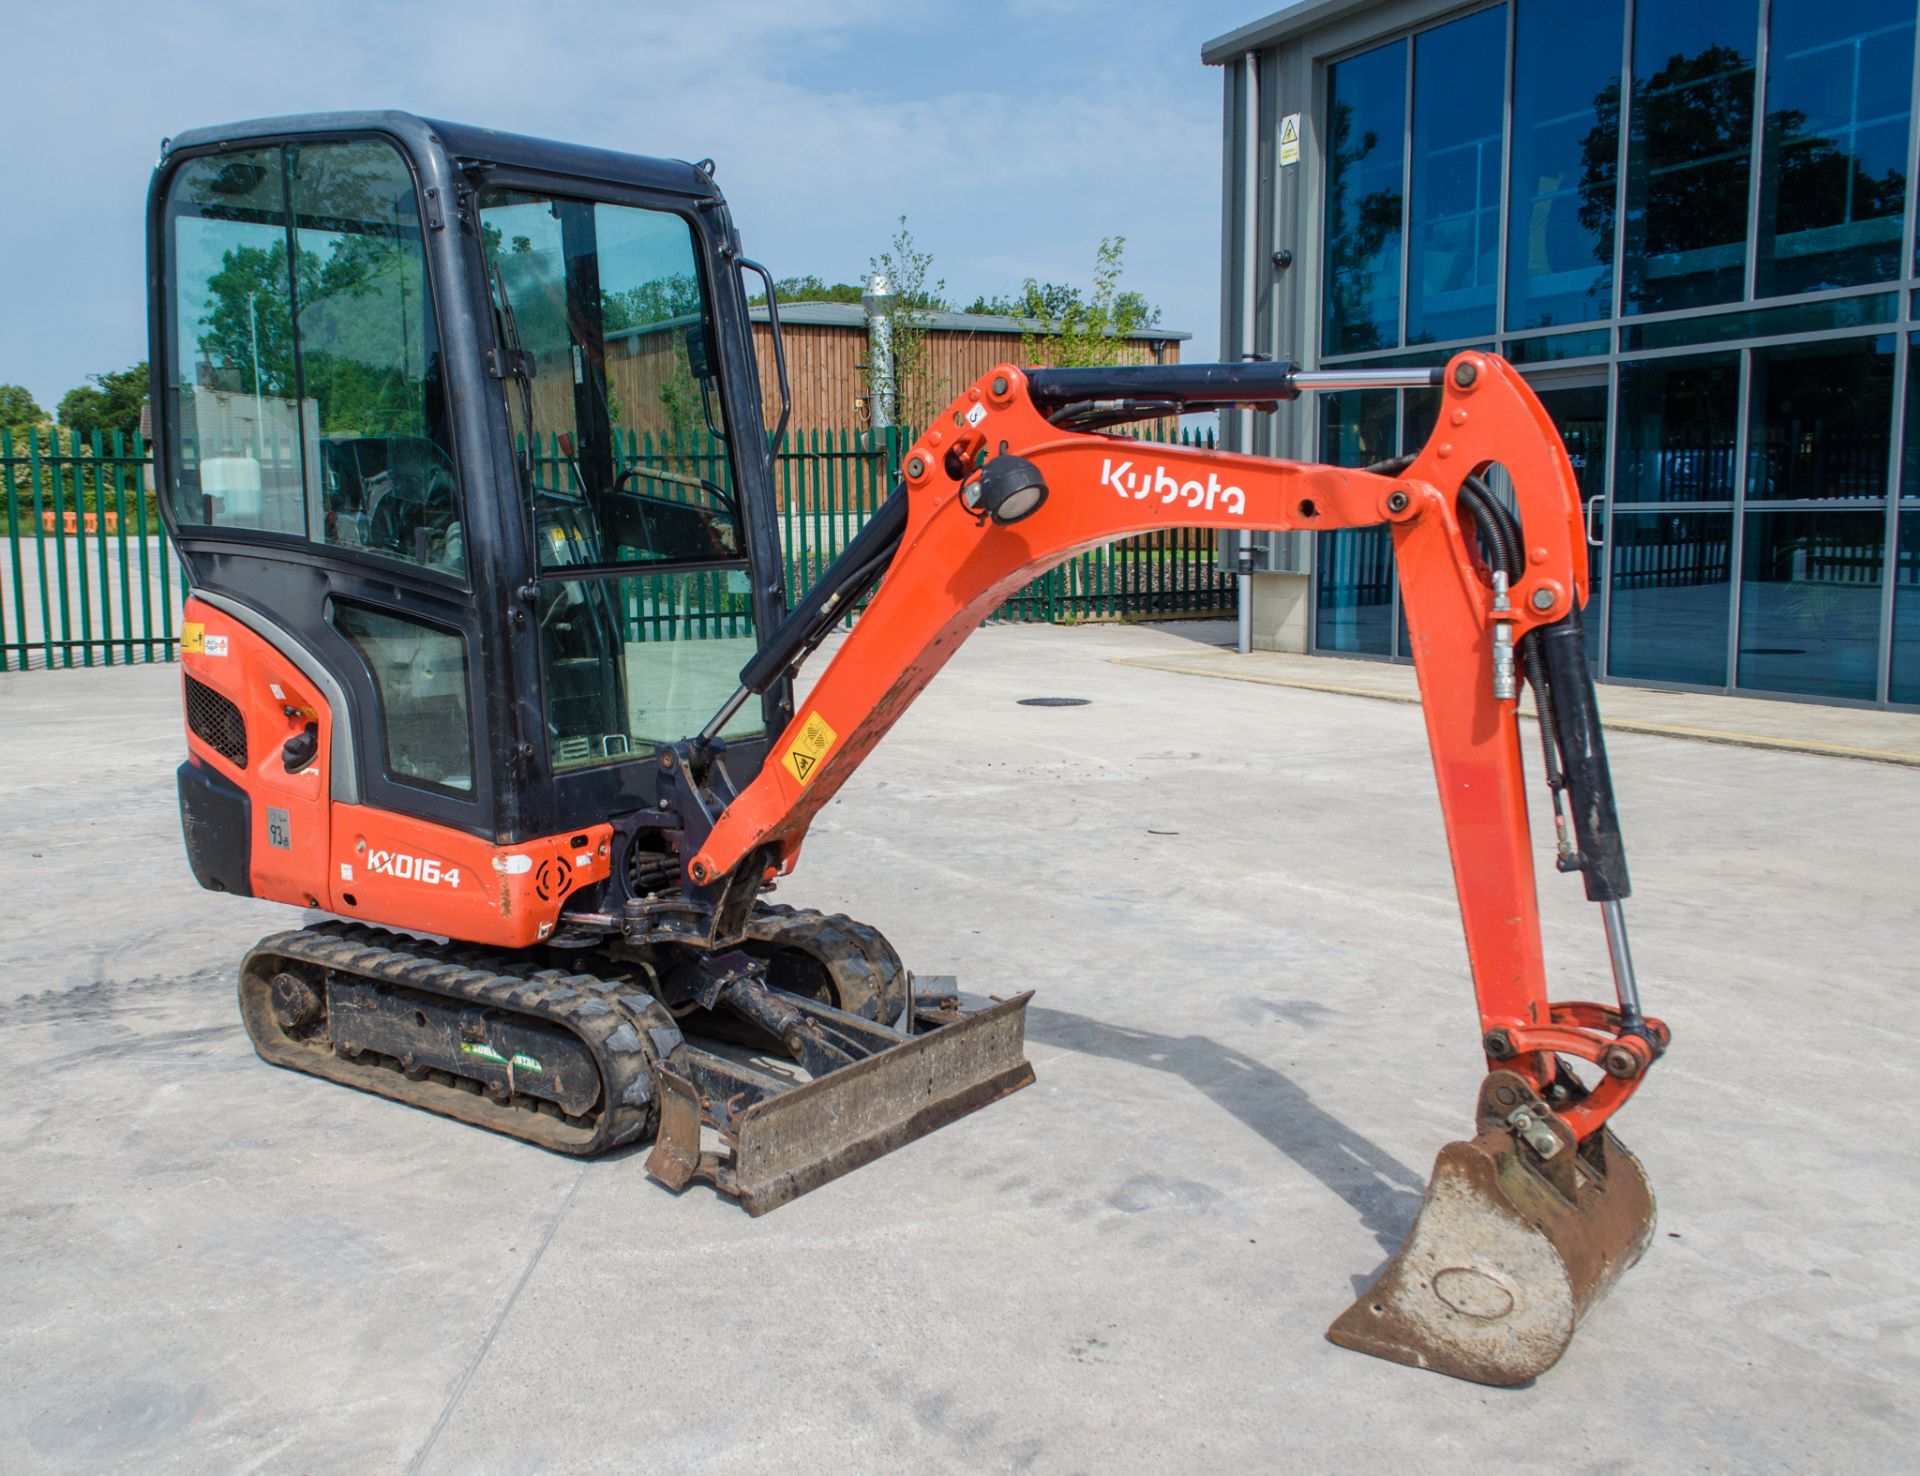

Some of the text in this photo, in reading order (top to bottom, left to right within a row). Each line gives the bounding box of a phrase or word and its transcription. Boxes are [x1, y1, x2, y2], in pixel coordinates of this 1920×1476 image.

[1101, 459, 1246, 515] Kubota
[270, 824, 283, 845] 93
[367, 849, 460, 888] KX016-4
